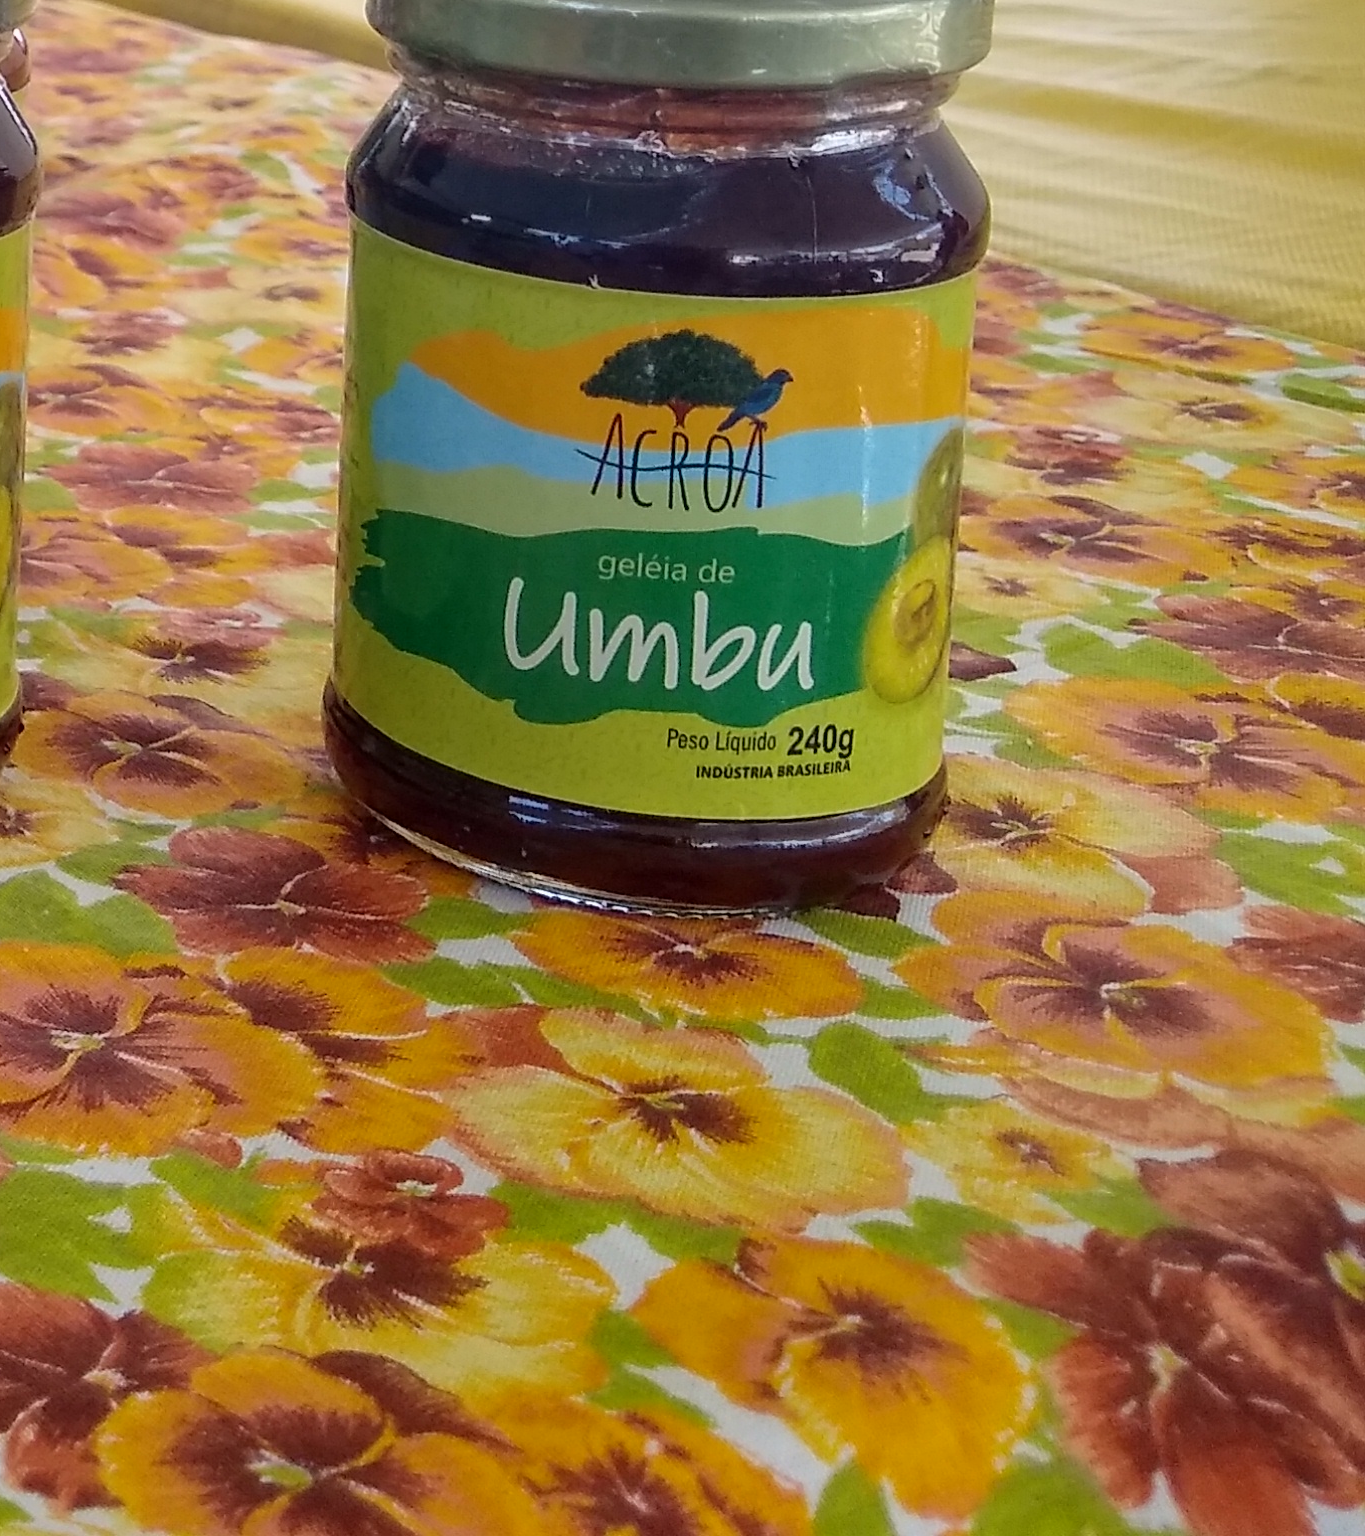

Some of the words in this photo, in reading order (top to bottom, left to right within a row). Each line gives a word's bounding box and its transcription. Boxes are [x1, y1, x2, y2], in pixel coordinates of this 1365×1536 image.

[597, 551, 688, 583] geléia
[698, 556, 736, 584] de
[502, 576, 815, 692] Umbu
[667, 727, 710, 751] Peso
[715, 730, 777, 756] Líquido
[786, 723, 855, 759] 240g
[695, 763, 774, 780] INDÚSTRIA
[776, 759, 851, 778] BRASILEIRA
